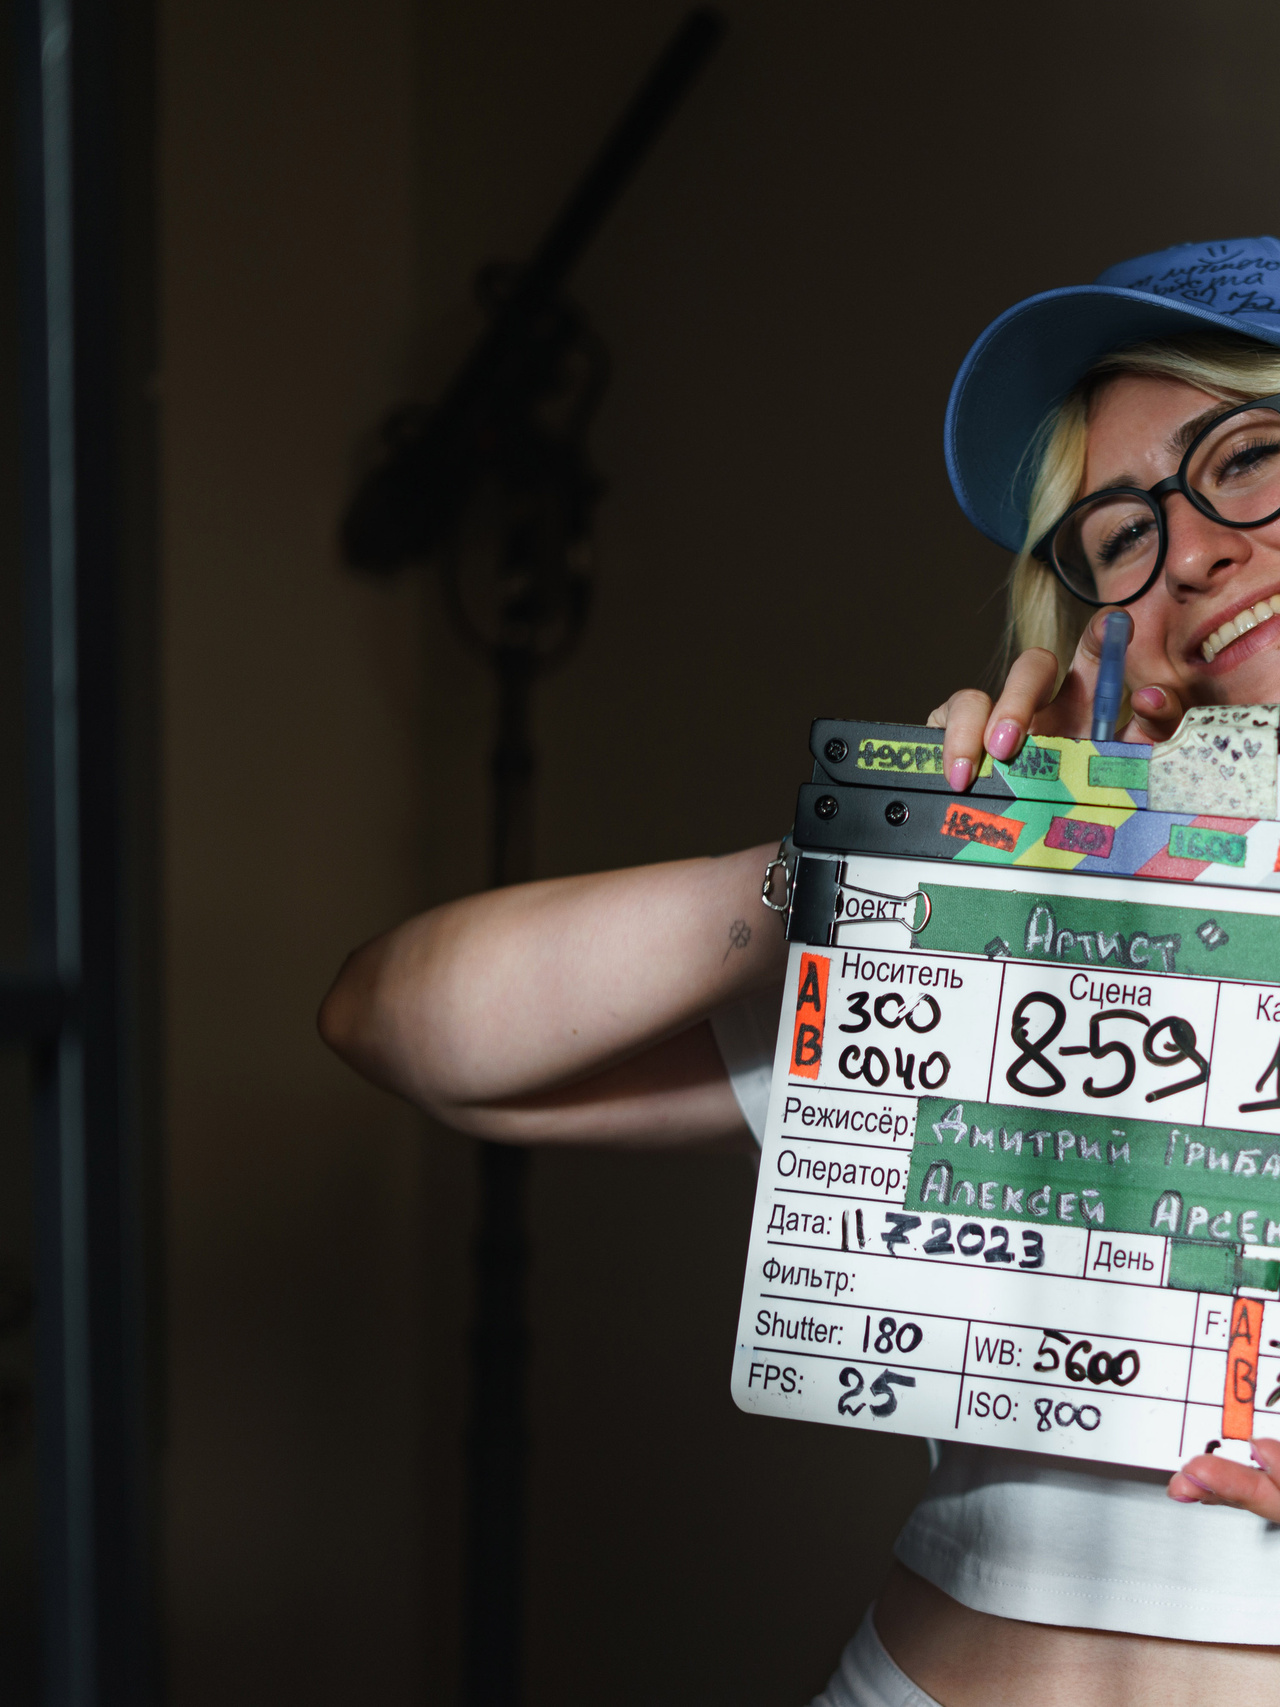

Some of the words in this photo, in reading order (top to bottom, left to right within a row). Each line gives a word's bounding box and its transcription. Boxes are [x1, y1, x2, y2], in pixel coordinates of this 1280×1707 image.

[841, 952, 964, 989] Носитель
[1069, 973, 1152, 1009] Сцена
[783, 1097, 915, 1141] Режиссёр:
[776, 1150, 908, 1194] Оператор:
[767, 1204, 831, 1236] Дата:
[1093, 1241, 1155, 1272] День
[762, 1257, 856, 1297] Фильтр:
[755, 1310, 843, 1345] Shutter:
[863, 1315, 923, 1354] 180
[974, 1336, 1022, 1367] WB:
[1033, 1329, 1141, 1387] 5600
[748, 1362, 804, 1395] FPS:
[838, 1366, 916, 1418] 25
[967, 1390, 1018, 1422] ISO:
[1034, 1398, 1102, 1432] 800
